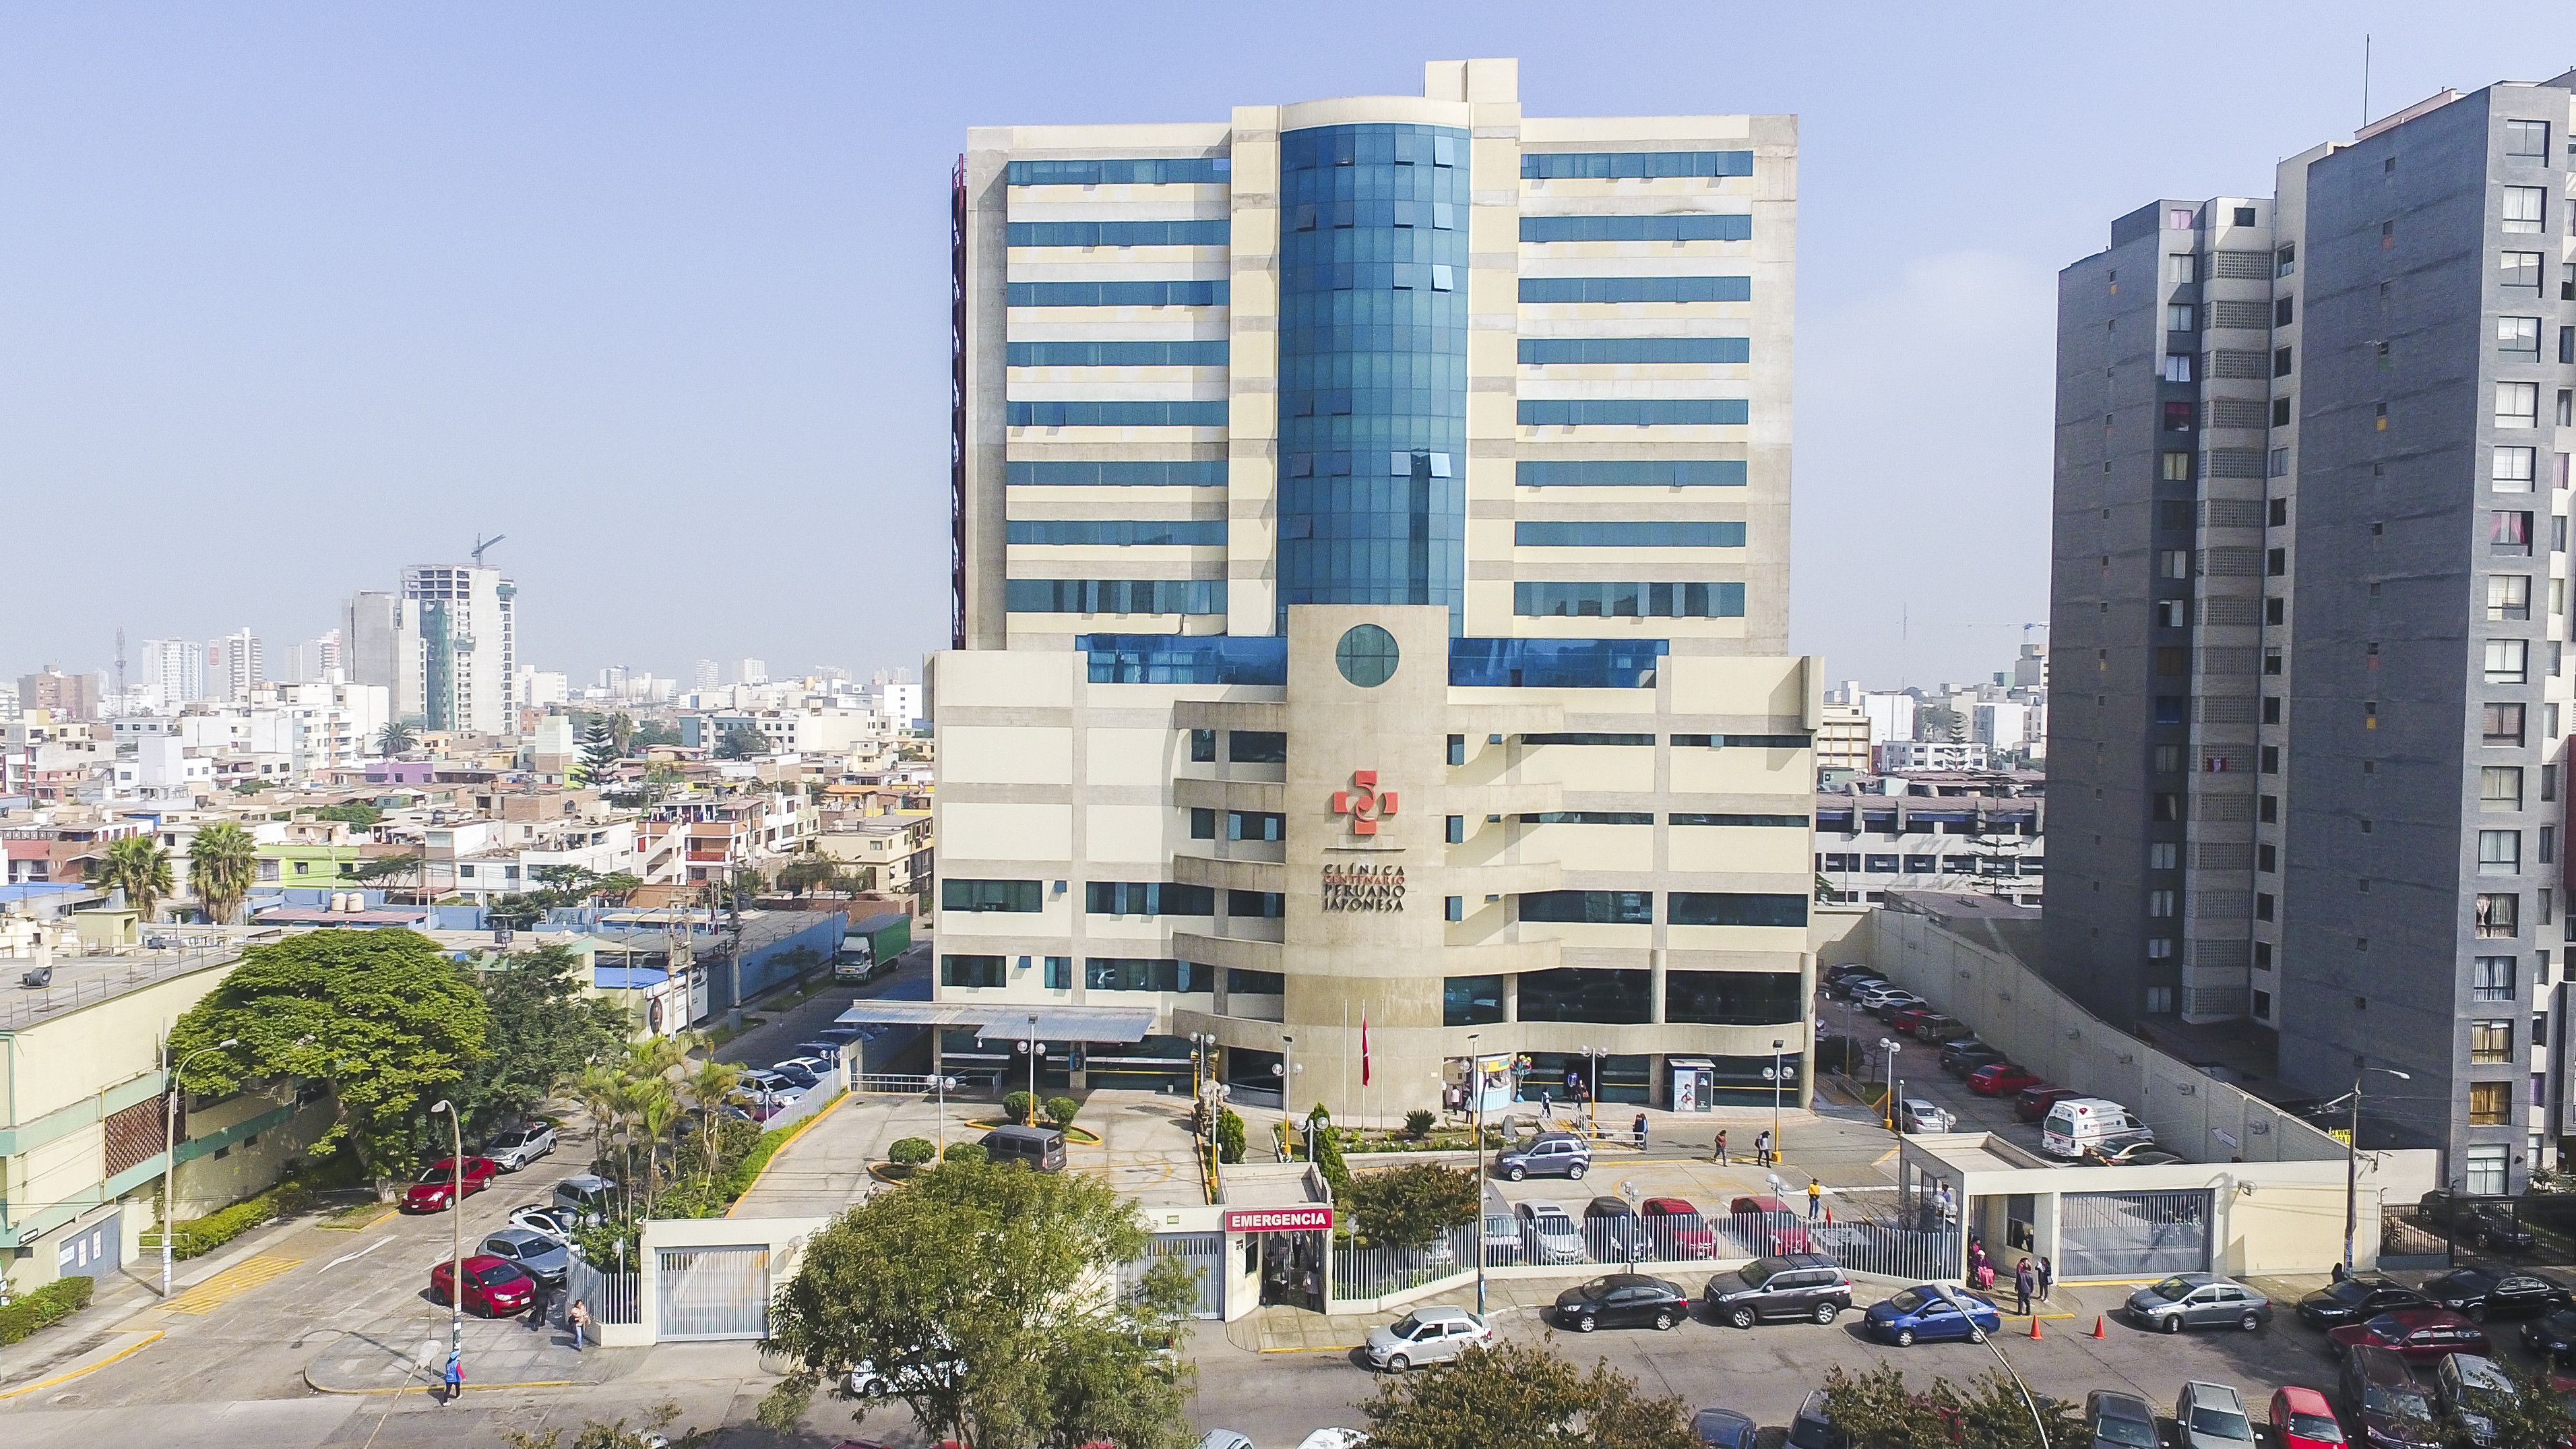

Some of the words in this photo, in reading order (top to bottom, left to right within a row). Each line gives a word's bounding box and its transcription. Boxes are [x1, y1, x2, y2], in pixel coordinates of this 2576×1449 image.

[1323, 863, 1404, 875] CLÍNICA
[1323, 875, 1405, 884] CENTENARIO
[1324, 884, 1406, 898] PERUANO
[1323, 898, 1404, 911] JAPONESA
[1232, 1212, 1326, 1227] EMERGENCIA
